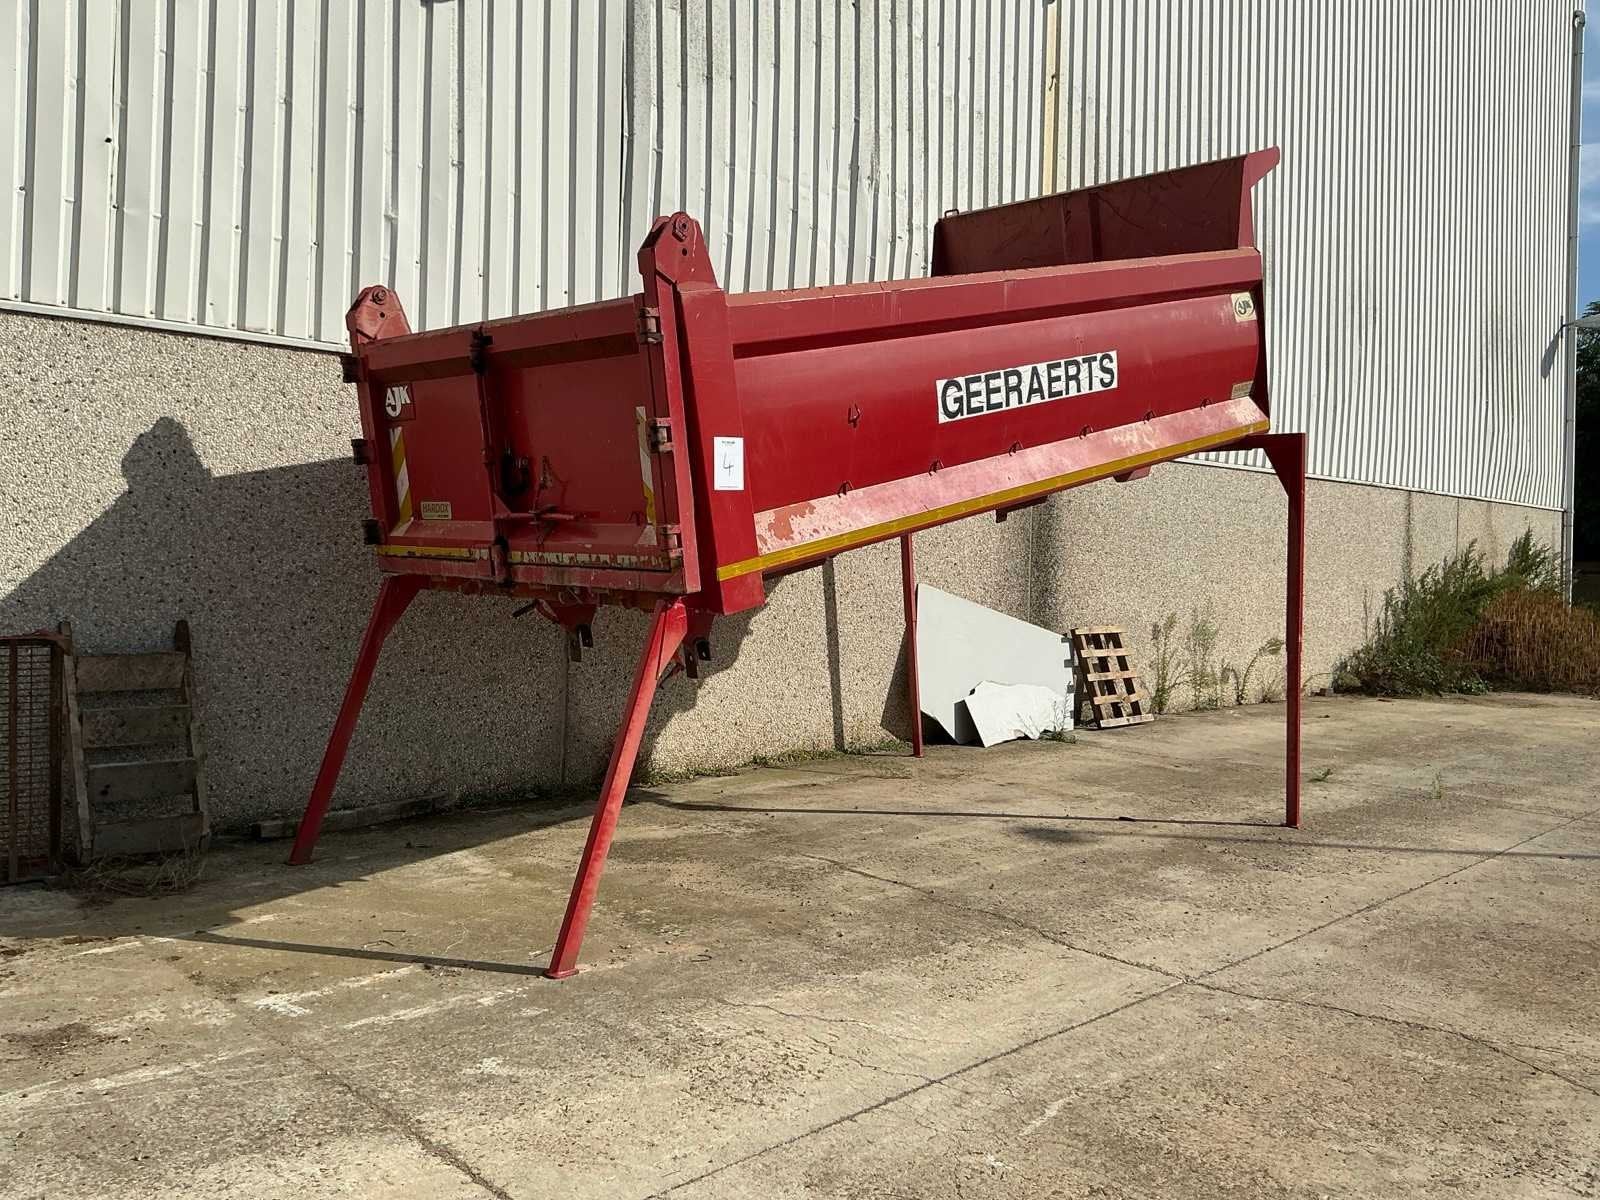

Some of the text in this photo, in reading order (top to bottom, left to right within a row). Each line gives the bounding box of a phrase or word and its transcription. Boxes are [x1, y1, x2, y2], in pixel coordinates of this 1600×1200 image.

[385, 385, 410, 417] AJK
[941, 353, 1115, 419] GEERAERTS
[722, 451, 735, 477] 4
